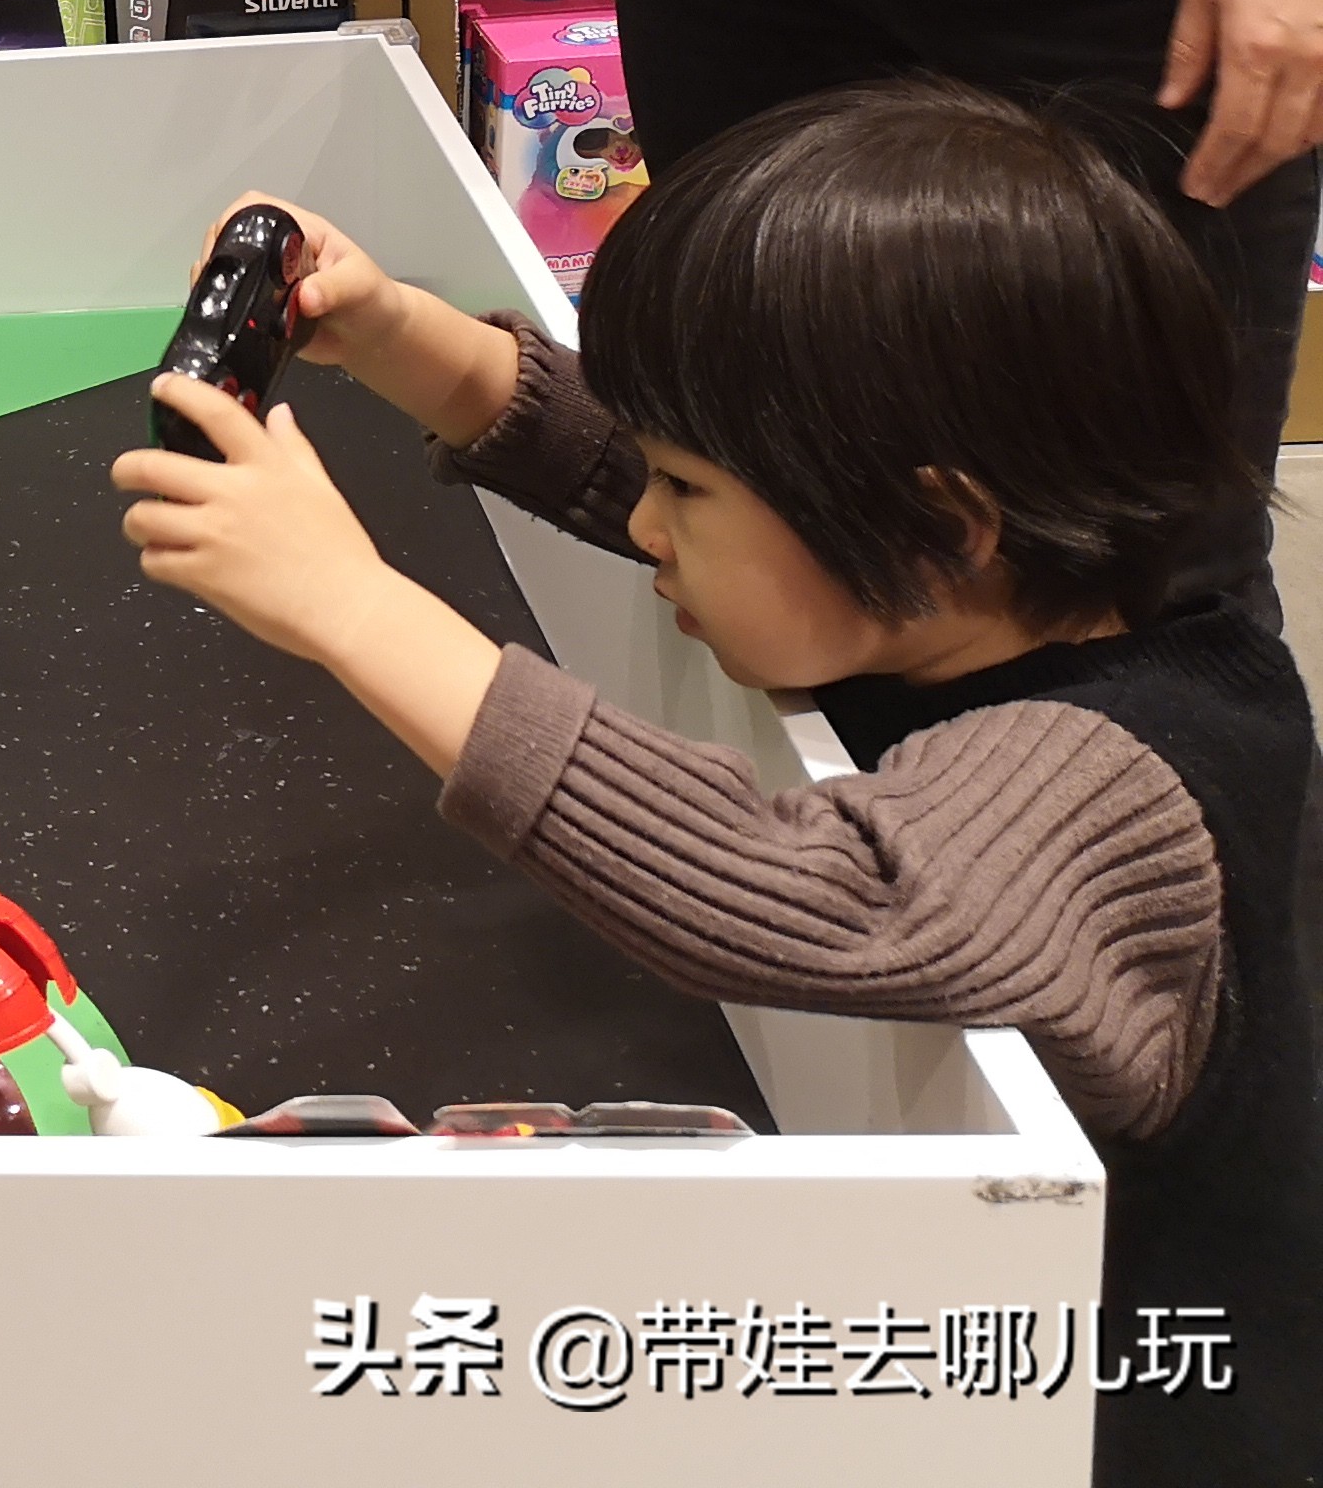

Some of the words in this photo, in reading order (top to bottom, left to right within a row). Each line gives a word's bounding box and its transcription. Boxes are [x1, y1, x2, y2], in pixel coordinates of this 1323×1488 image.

[532, 79, 577, 103] Tiny
[523, 95, 596, 121] Furries
[546, 253, 596, 270] MAMA
